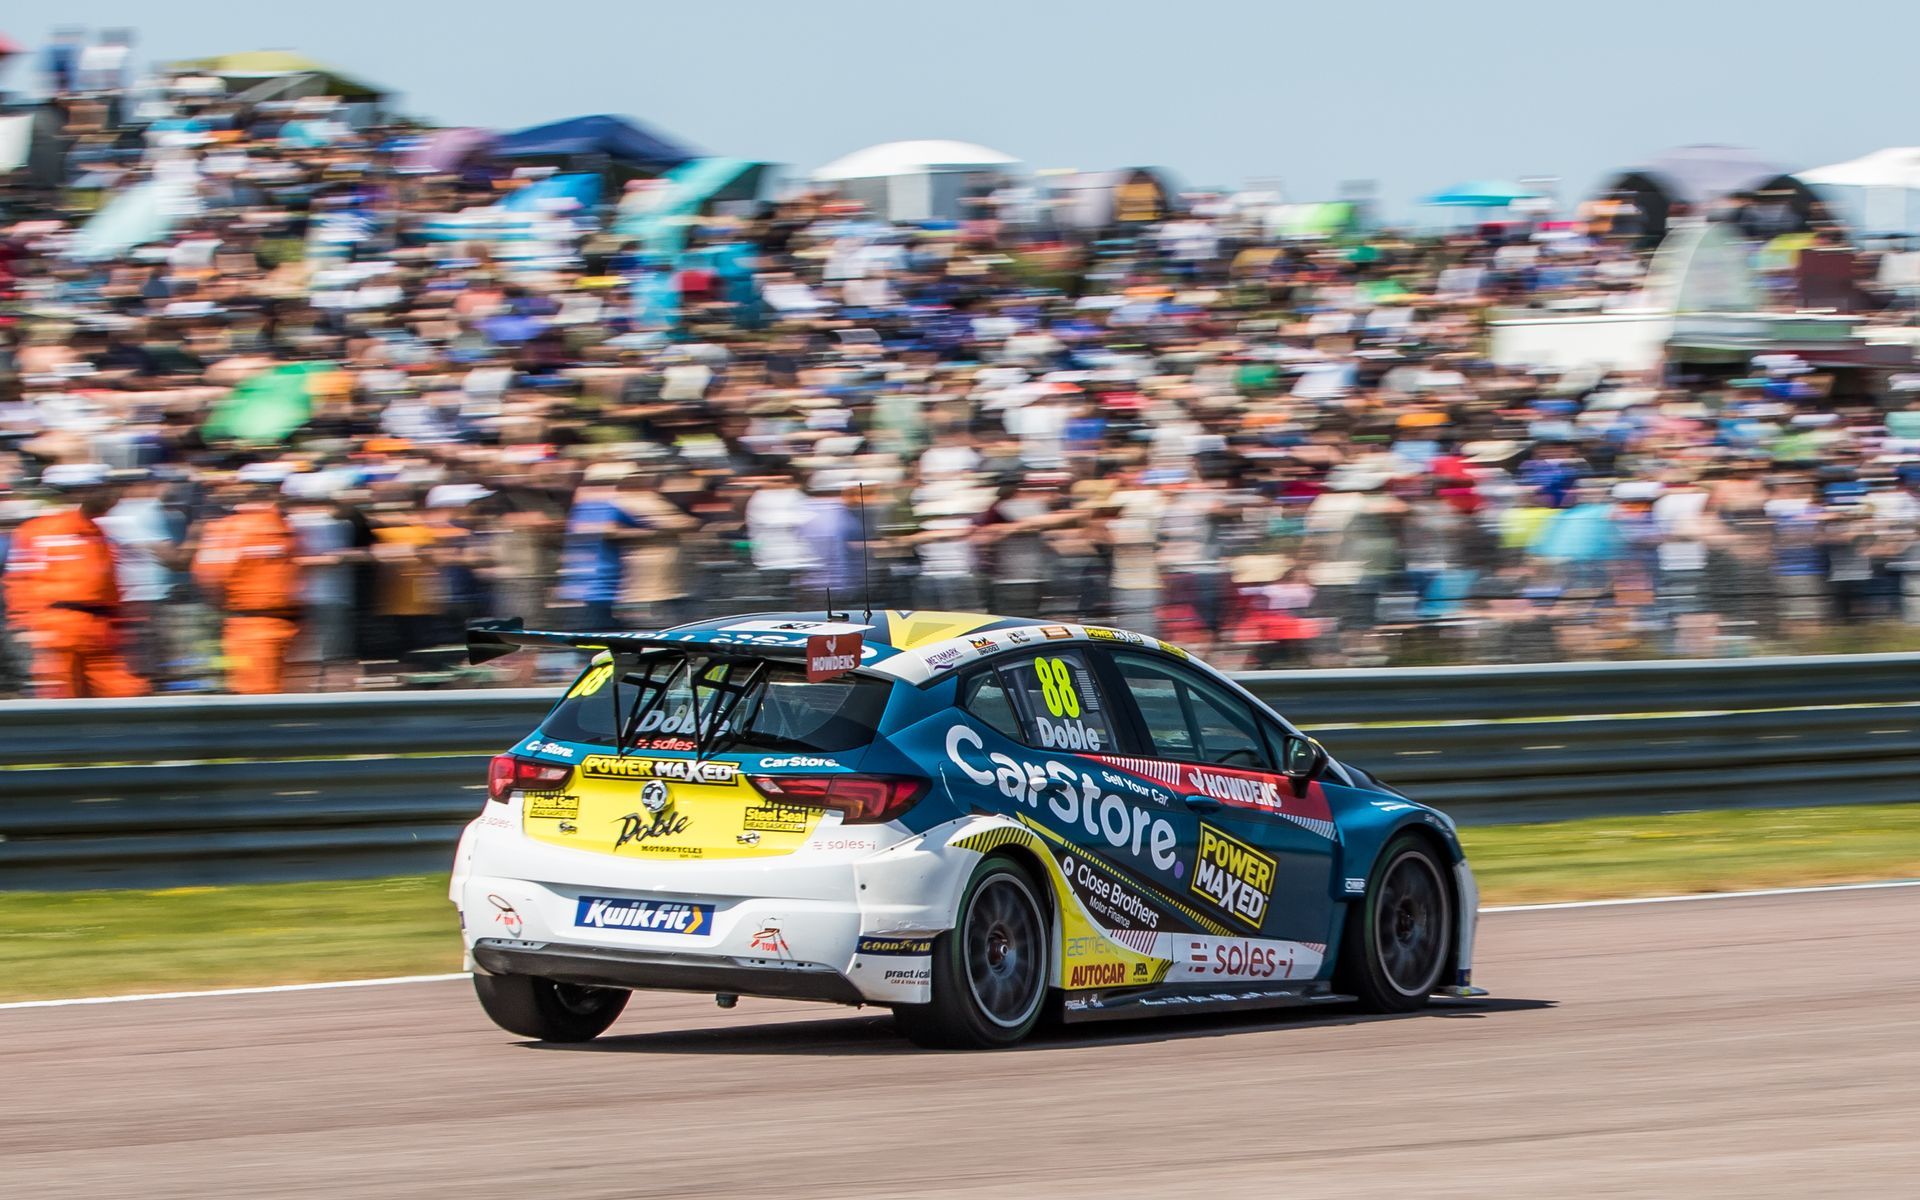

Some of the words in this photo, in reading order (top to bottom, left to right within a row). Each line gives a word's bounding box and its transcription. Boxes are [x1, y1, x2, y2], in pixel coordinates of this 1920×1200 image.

[811, 653, 856, 672] HOWDENS
[925, 647, 960, 667] METAMARK
[1034, 656, 1081, 719] 88
[1036, 716, 1101, 751] Doble
[584, 756, 653, 776] POWER
[653, 759, 733, 784] MAXED
[1101, 770, 1124, 787] Sell
[1123, 776, 1150, 798] Your
[1202, 773, 1282, 808] HOWDENS
[745, 807, 779, 821] Steel
[778, 809, 806, 823] Seal
[610, 812, 694, 853] Doble
[641, 845, 703, 853] MOTORCYCLES
[1202, 831, 1270, 893] POWER
[1077, 864, 1110, 899] Close
[1110, 883, 1160, 928] Brothers
[1195, 858, 1264, 918] MAXED
[1089, 895, 1108, 913] Motor
[1107, 905, 1132, 929] Finance
[761, 942, 778, 952] TOW
[1070, 962, 1125, 987] AUTOCAR
[1133, 962, 1148, 976] JFA
